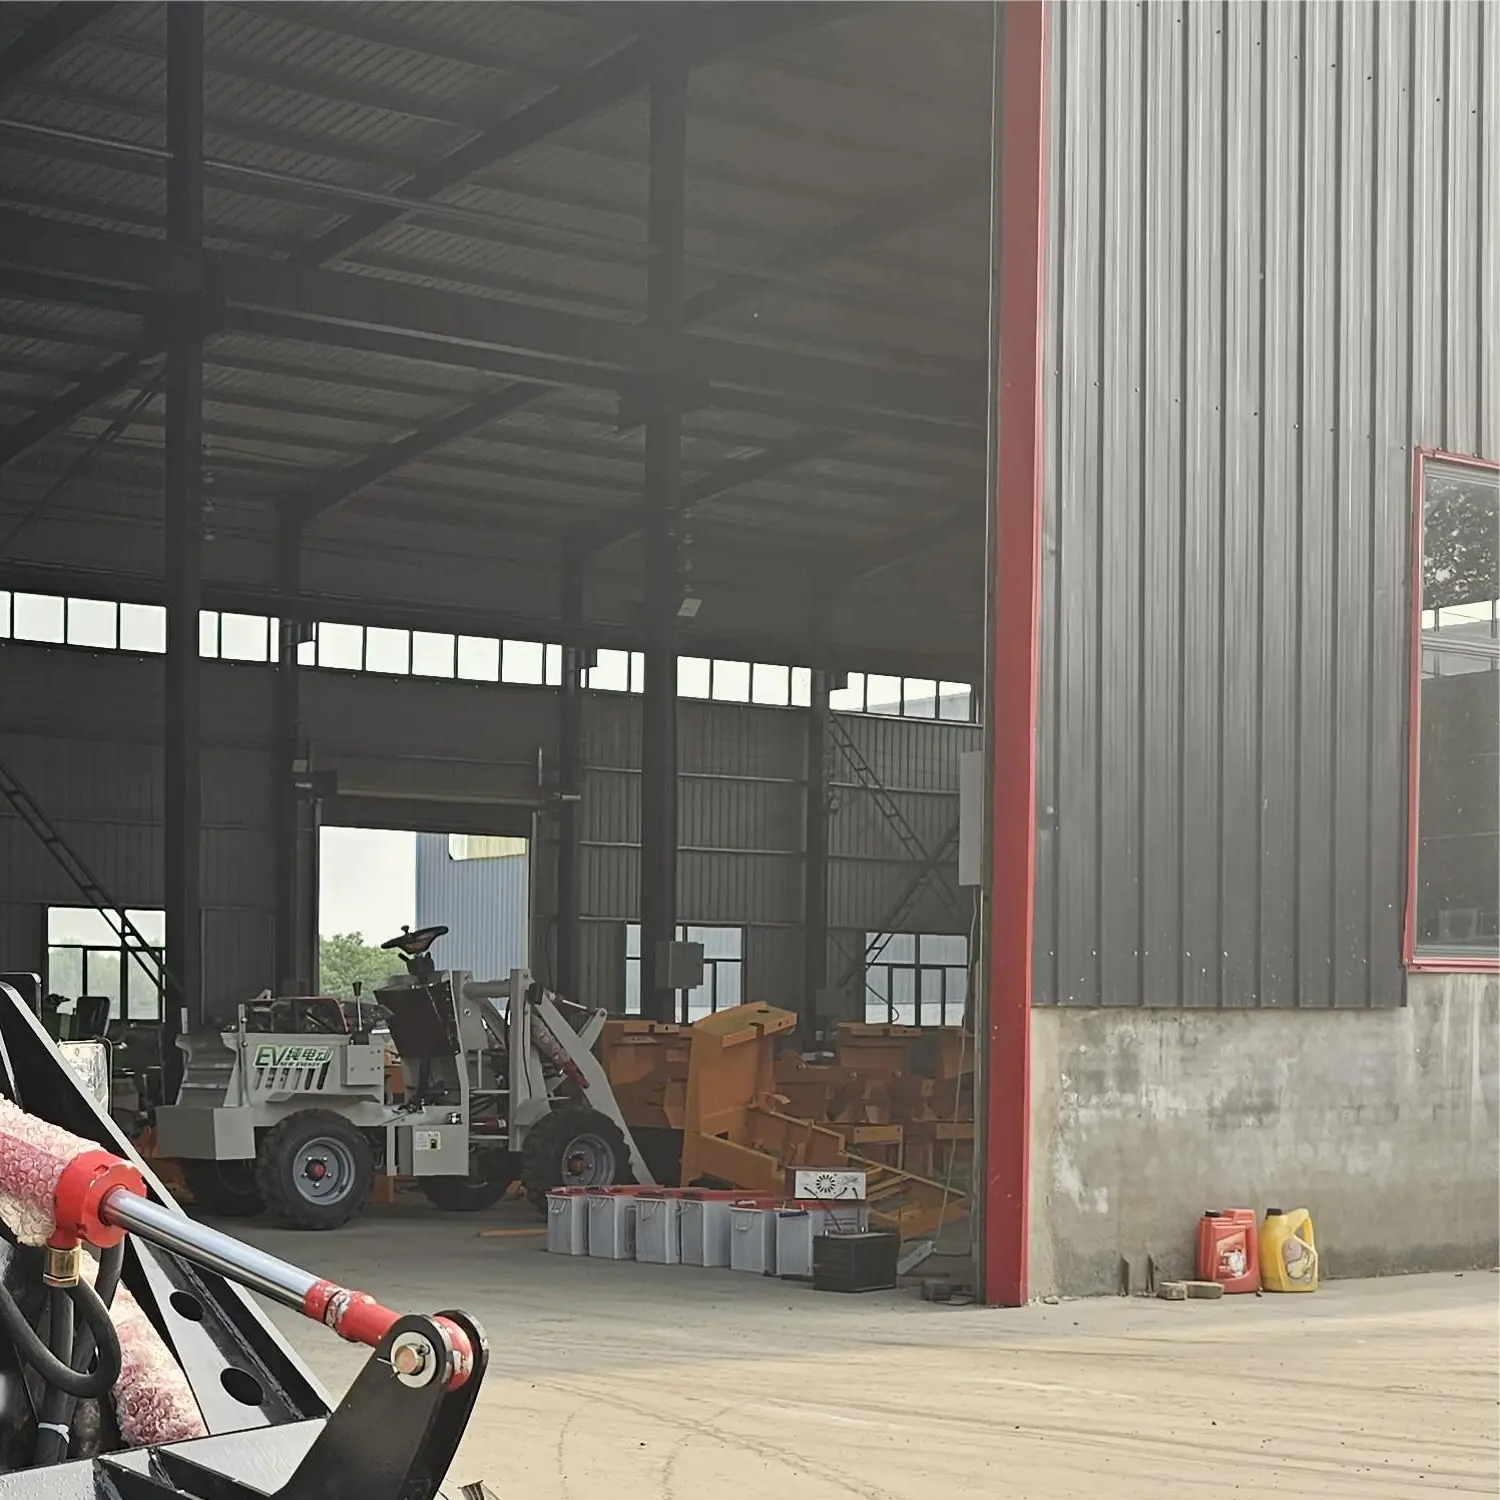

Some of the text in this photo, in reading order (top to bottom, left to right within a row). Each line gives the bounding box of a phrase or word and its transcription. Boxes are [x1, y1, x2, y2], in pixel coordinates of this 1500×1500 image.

[255, 1046, 333, 1066] EV 纯电动
